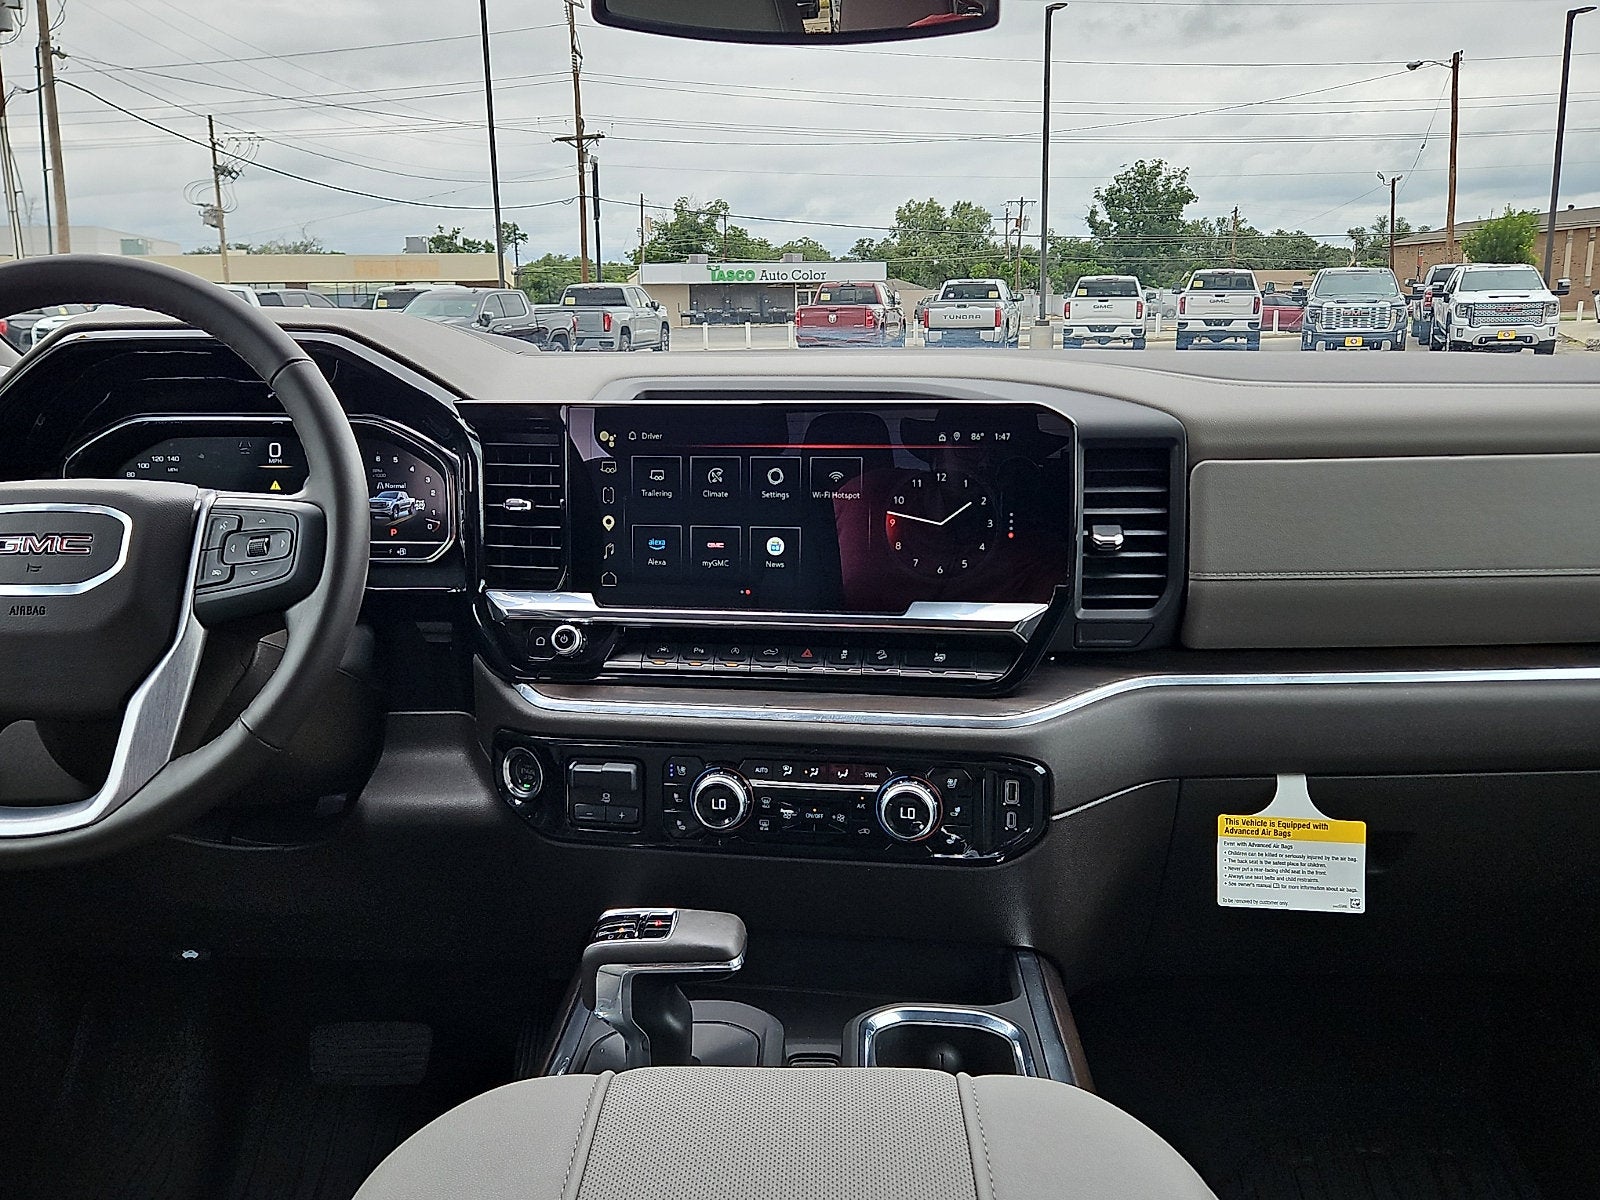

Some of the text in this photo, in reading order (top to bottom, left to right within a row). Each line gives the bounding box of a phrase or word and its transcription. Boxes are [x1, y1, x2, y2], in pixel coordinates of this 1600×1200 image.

[706, 265, 826, 281] TASCO Auto Color
[642, 432, 662, 440] Driver
[970, 432, 984, 440] 86°
[994, 432, 1010, 440] 1:47
[268, 442, 282, 458] 0
[936, 473, 946, 482] 12
[912, 479, 922, 487] 11
[964, 479, 968, 487] 1
[641, 489, 673, 498] Trailering
[702, 490, 728, 498] Climate
[762, 491, 790, 500] Settings
[832, 492, 860, 500] Hotspot
[894, 496, 904, 504] 10
[981, 497, 986, 505] 2
[889, 519, 896, 527] 9
[987, 520, 993, 528] 3
[895, 542, 901, 550] 8
[648, 558, 667, 566] Alexa
[702, 560, 729, 568] myGMC
[913, 559, 919, 567] 7
[962, 560, 968, 568] 5
[9, 606, 46, 616] AIRBAG
[1278, 821, 1310, 830] Equipped
[1224, 827, 1259, 835] Advanced
[1274, 830, 1291, 838] Bags
